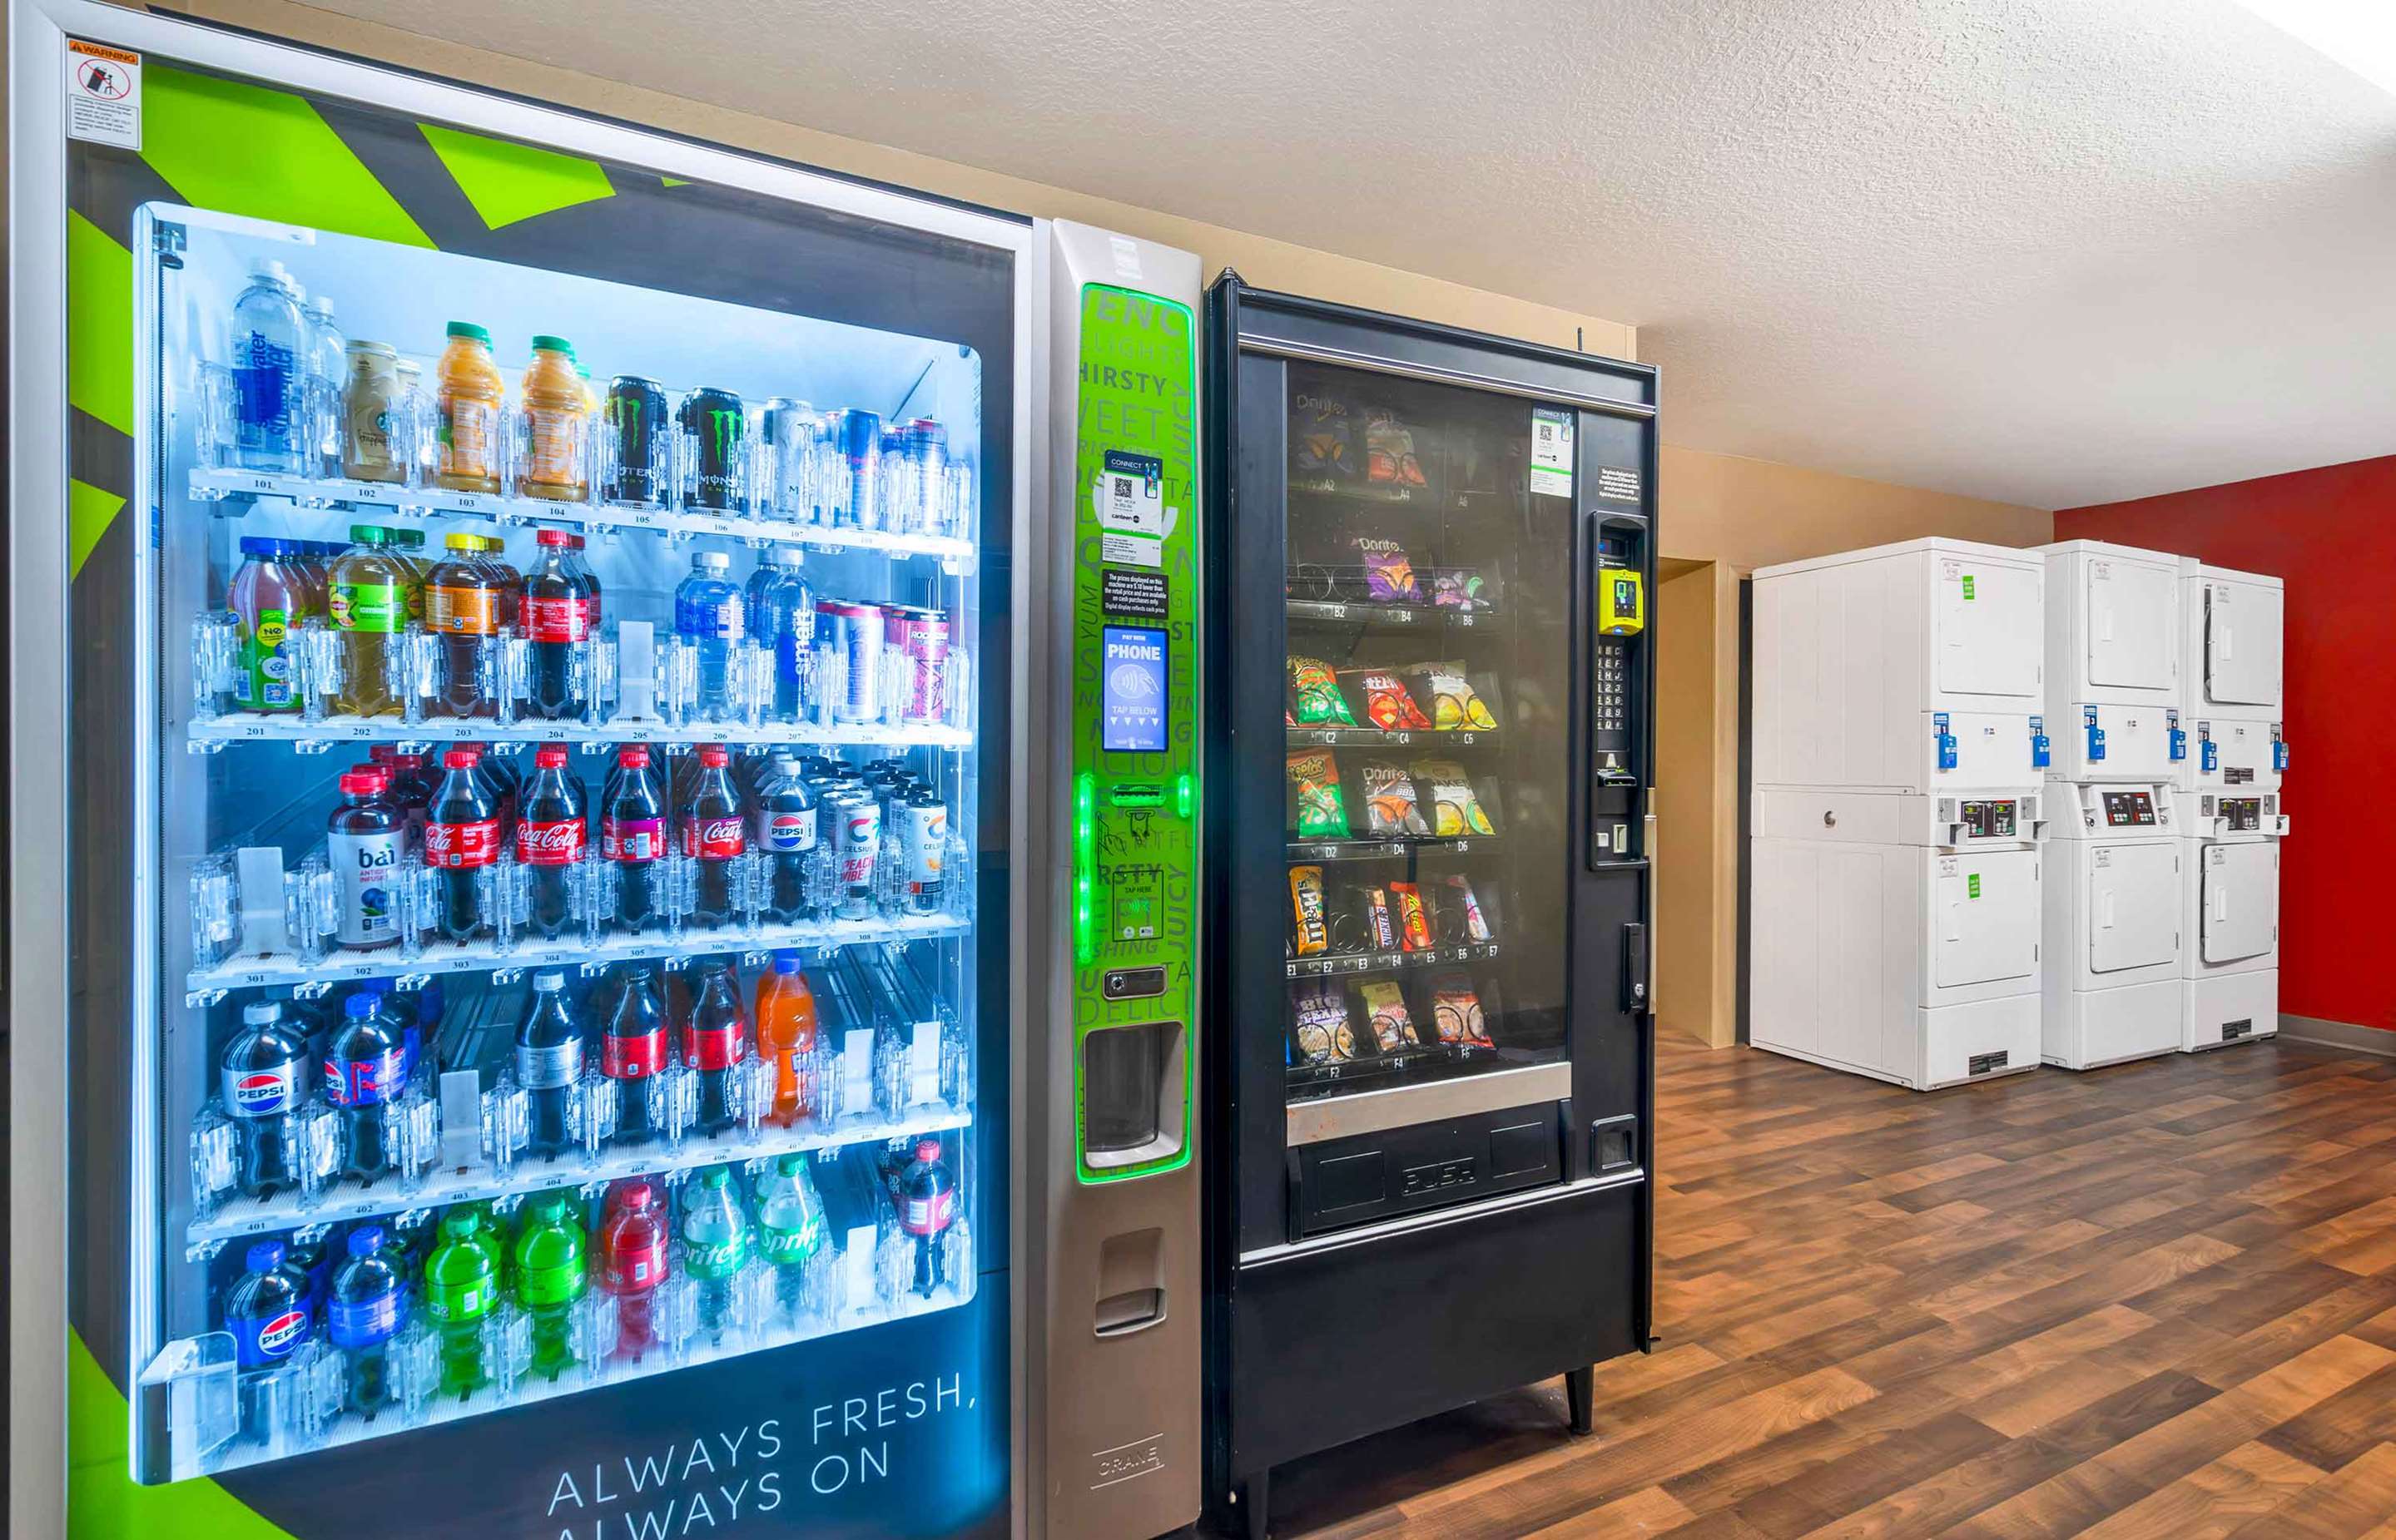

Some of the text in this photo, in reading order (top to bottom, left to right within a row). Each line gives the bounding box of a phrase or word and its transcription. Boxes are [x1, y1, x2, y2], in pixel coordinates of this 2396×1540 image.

[83, 46, 136, 62] WARNING
[1111, 458, 1141, 469] CONNECT
[255, 479, 273, 489] 101
[1324, 479, 1335, 492] A2
[359, 488, 376, 498] 102
[1400, 488, 1411, 500] A4
[459, 498, 474, 507] 103
[549, 507, 565, 516] 104
[714, 523, 728, 532] 106
[1334, 607, 1345, 618] B2
[1401, 611, 1411, 621] B4
[1463, 616, 1473, 626] B6
[1108, 644, 1161, 661] PHONE
[1112, 706, 1157, 715] TAP BELOW
[246, 727, 265, 735] 201
[1326, 732, 1336, 744] C2
[1400, 733, 1409, 744] C4
[1464, 733, 1473, 744] C6
[518, 822, 581, 848] Coca-Cola
[1394, 844, 1404, 855] D4
[1458, 841, 1468, 851] D6
[359, 843, 395, 869] bai
[1326, 847, 1337, 858] D2
[844, 855, 874, 870] PEACH
[841, 869, 864, 882] VIBE
[1458, 948, 1467, 959] E6
[1489, 945, 1497, 956] E7
[543, 954, 559, 963] 304
[1392, 955, 1401, 966] E4
[1426, 952, 1436, 963] E5
[454, 961, 469, 969] 303
[1323, 961, 1332, 972] E2
[1358, 958, 1367, 969] E3
[1287, 965, 1297, 976] E1
[246, 975, 265, 983] 301
[1461, 1048, 1470, 1058] F6
[1394, 1058, 1403, 1068] F4
[1330, 1067, 1340, 1078] F2
[238, 1087, 285, 1100] PEPSI
[452, 1192, 469, 1201] 403
[356, 1206, 373, 1214] 402
[247, 1222, 265, 1231] 401
[261, 1320, 306, 1344] PEPSI
[548, 1372, 975, 1516] ALWAYS FRESH,
[1099, 1447, 1158, 1476] CRANE
[811, 1441, 888, 1494] ON
